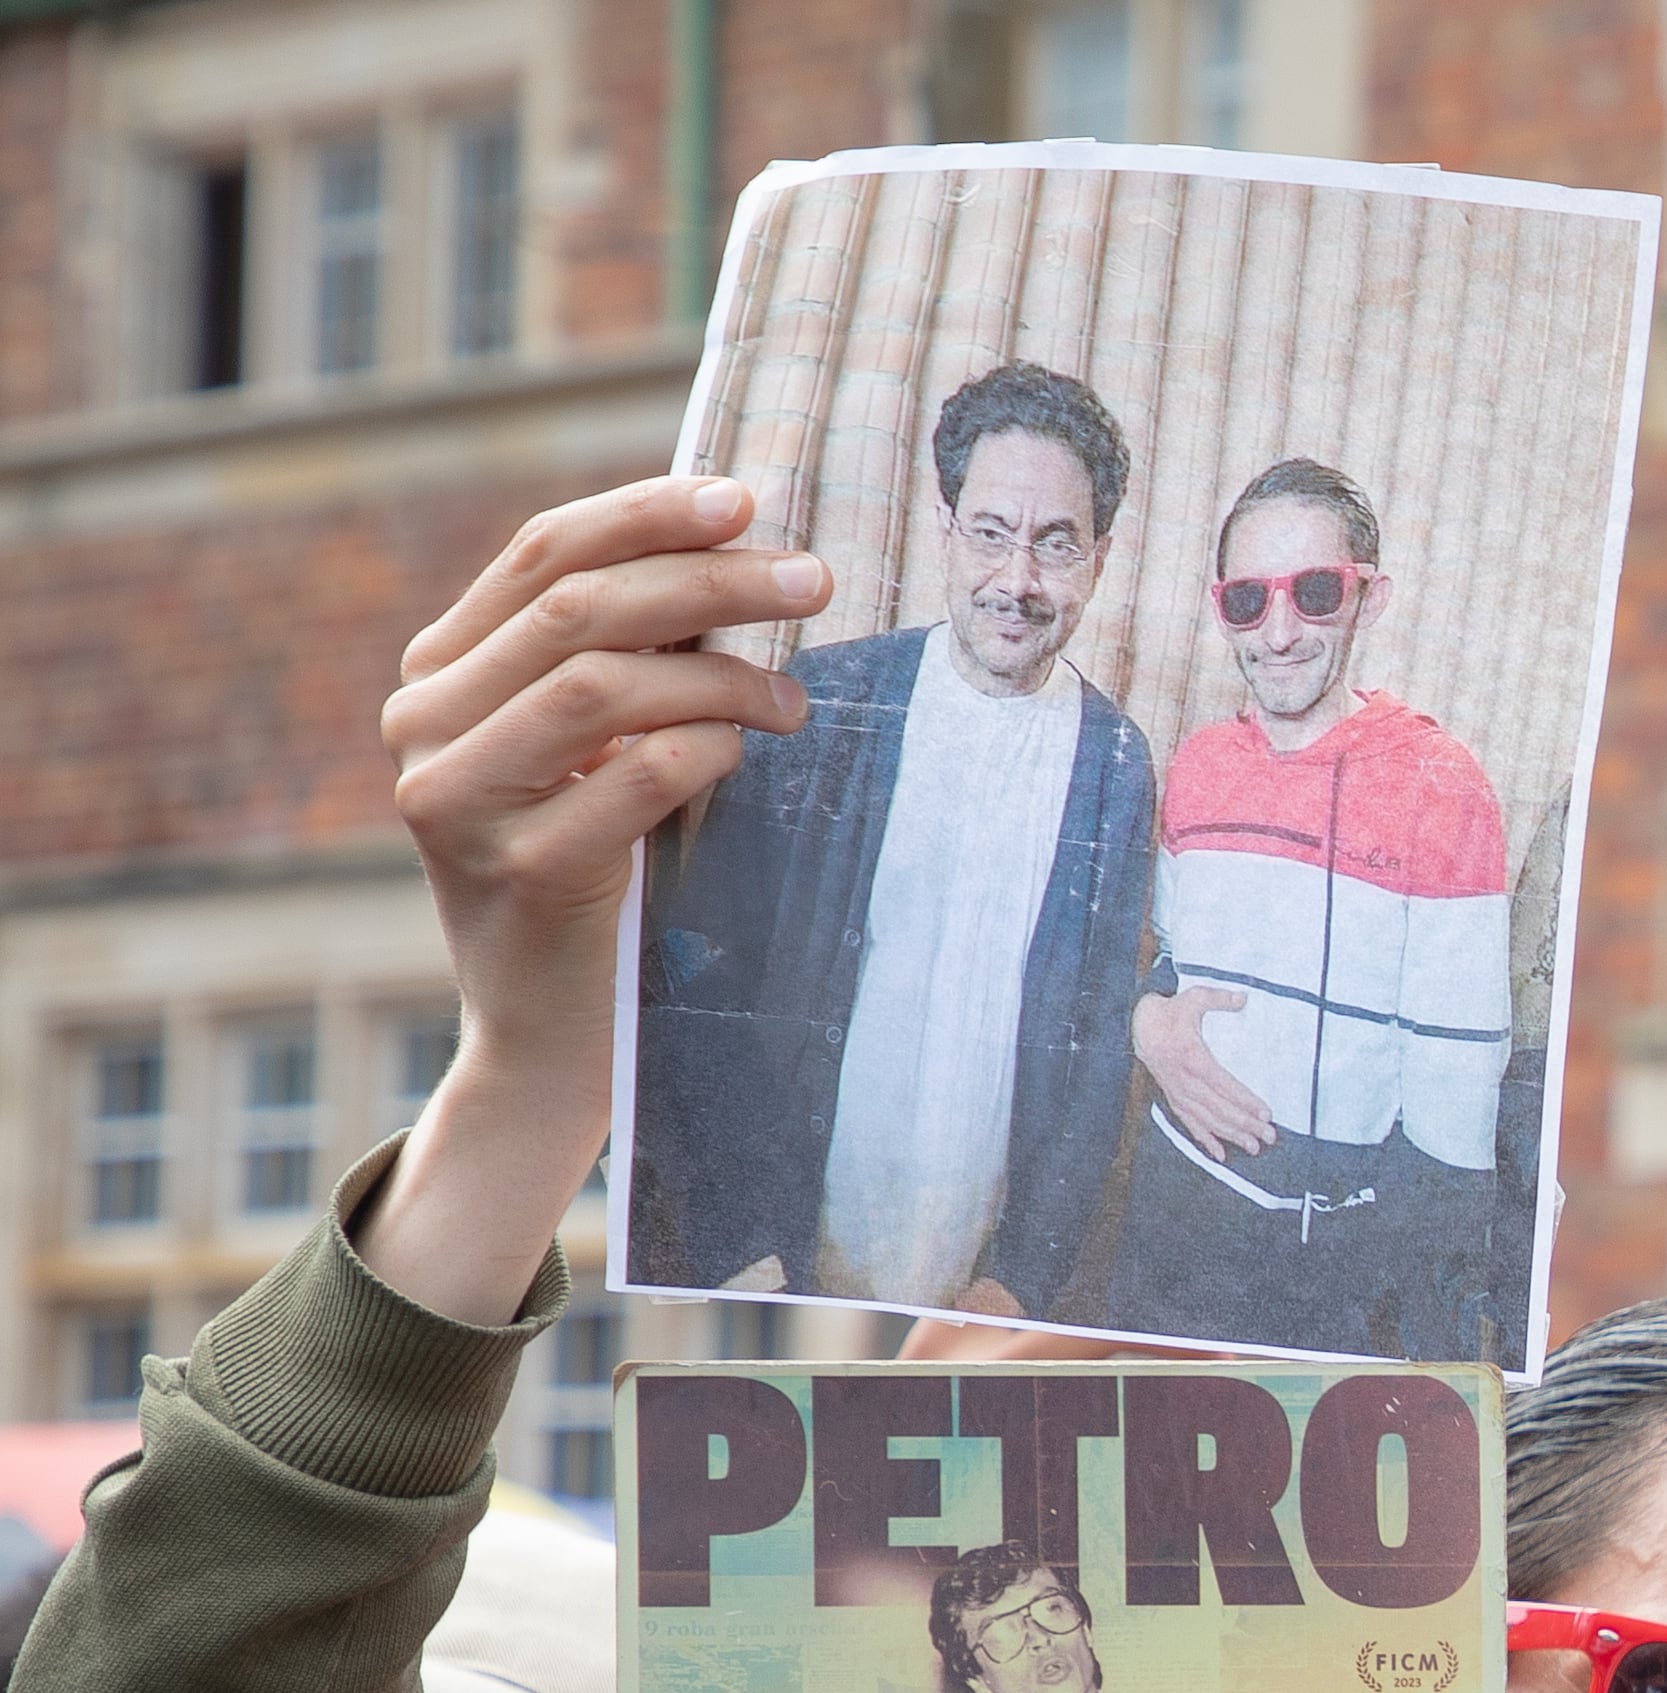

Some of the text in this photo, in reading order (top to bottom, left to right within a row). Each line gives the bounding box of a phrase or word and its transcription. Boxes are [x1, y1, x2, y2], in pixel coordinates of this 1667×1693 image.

[637, 1374, 1480, 1609] PETRO
[1376, 1653, 1438, 1671] FICM
[1394, 1677, 1421, 1687] 2023
